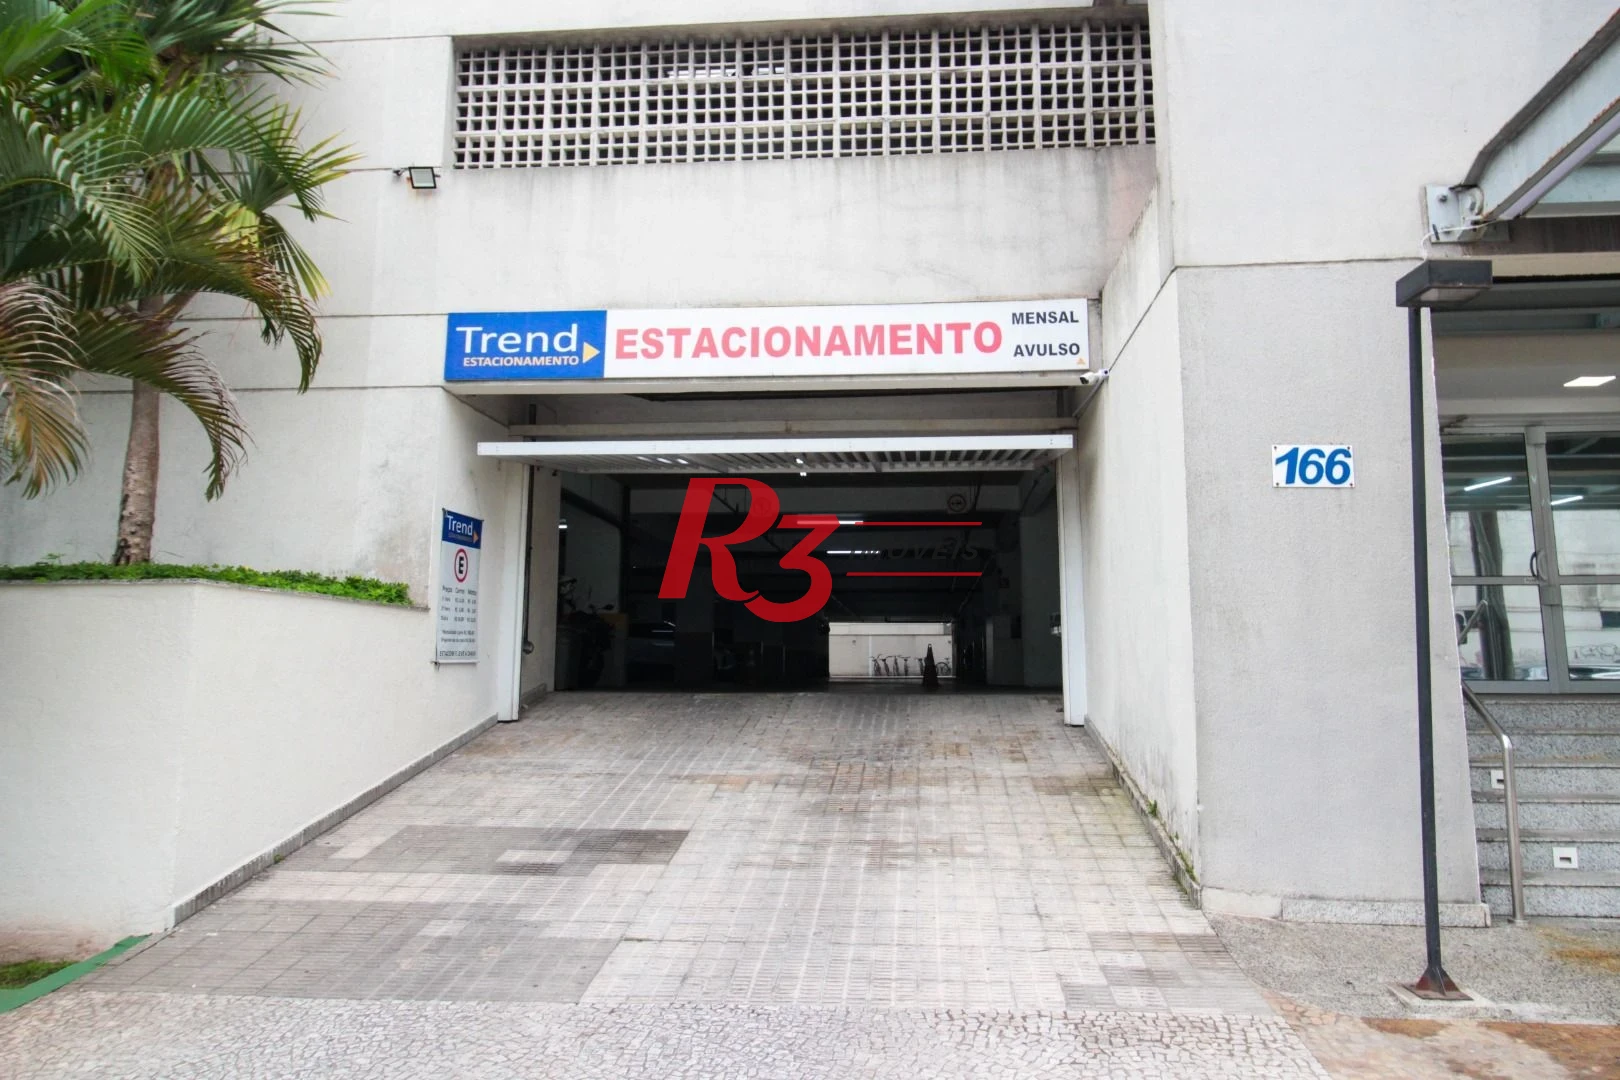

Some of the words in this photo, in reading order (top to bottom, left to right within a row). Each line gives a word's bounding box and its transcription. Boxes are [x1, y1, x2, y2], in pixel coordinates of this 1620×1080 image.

[1011, 310, 1080, 325] MENSAL
[455, 323, 578, 354] Trend
[614, 321, 1003, 360] ESTACIONAMENTO
[1013, 342, 1081, 358] AVULSO
[462, 355, 580, 368] ESTACIONAMENTO
[1275, 447, 1352, 486] 166
[446, 514, 473, 536] Trend
[458, 555, 465, 575] E
